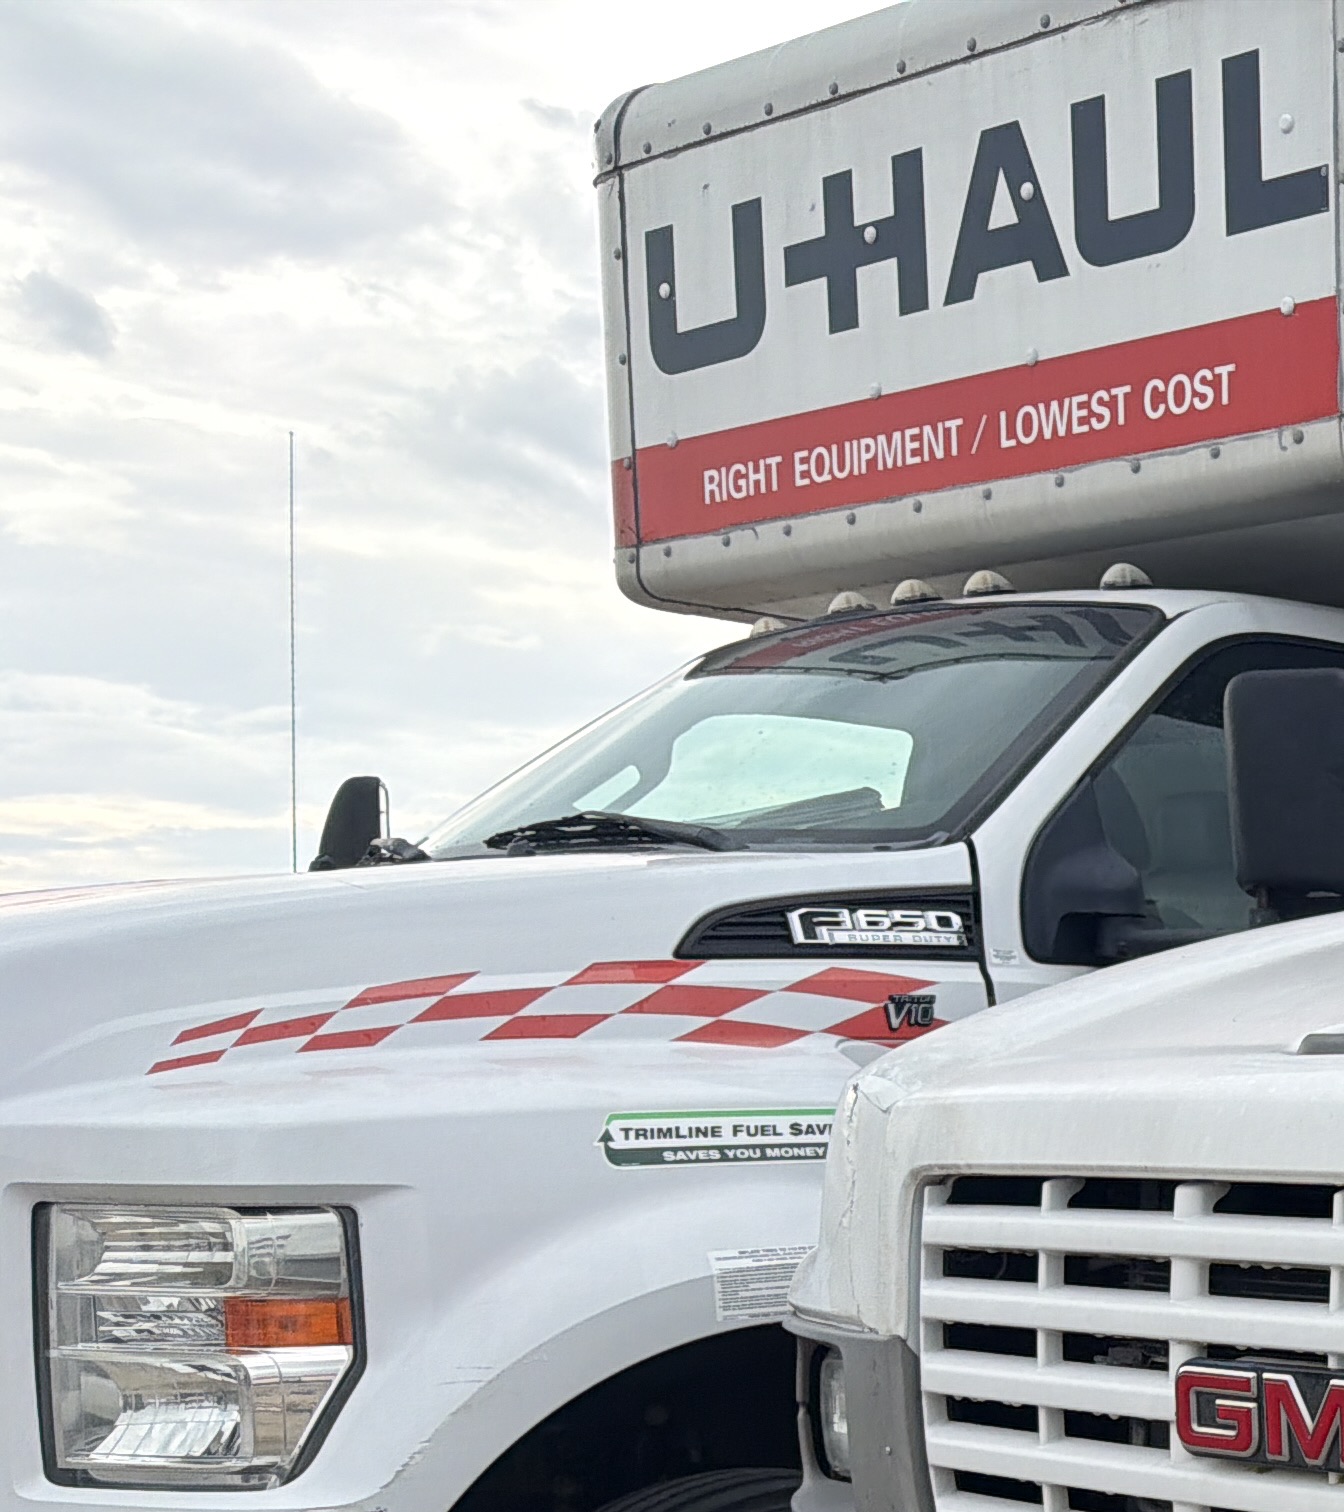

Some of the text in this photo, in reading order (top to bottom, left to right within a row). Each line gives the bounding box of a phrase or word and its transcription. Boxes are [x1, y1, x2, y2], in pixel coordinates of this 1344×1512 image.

[703, 363, 1236, 504] RIGHT EQUIPMENT / LOWEST COST
[847, 934, 954, 943] SUPER DUTY
[887, 1003, 932, 1029] V10
[619, 1124, 723, 1141] TRIMLINE
[732, 1124, 783, 1138] FUEL
[662, 1146, 826, 1162] SAVES YOU MONEY
